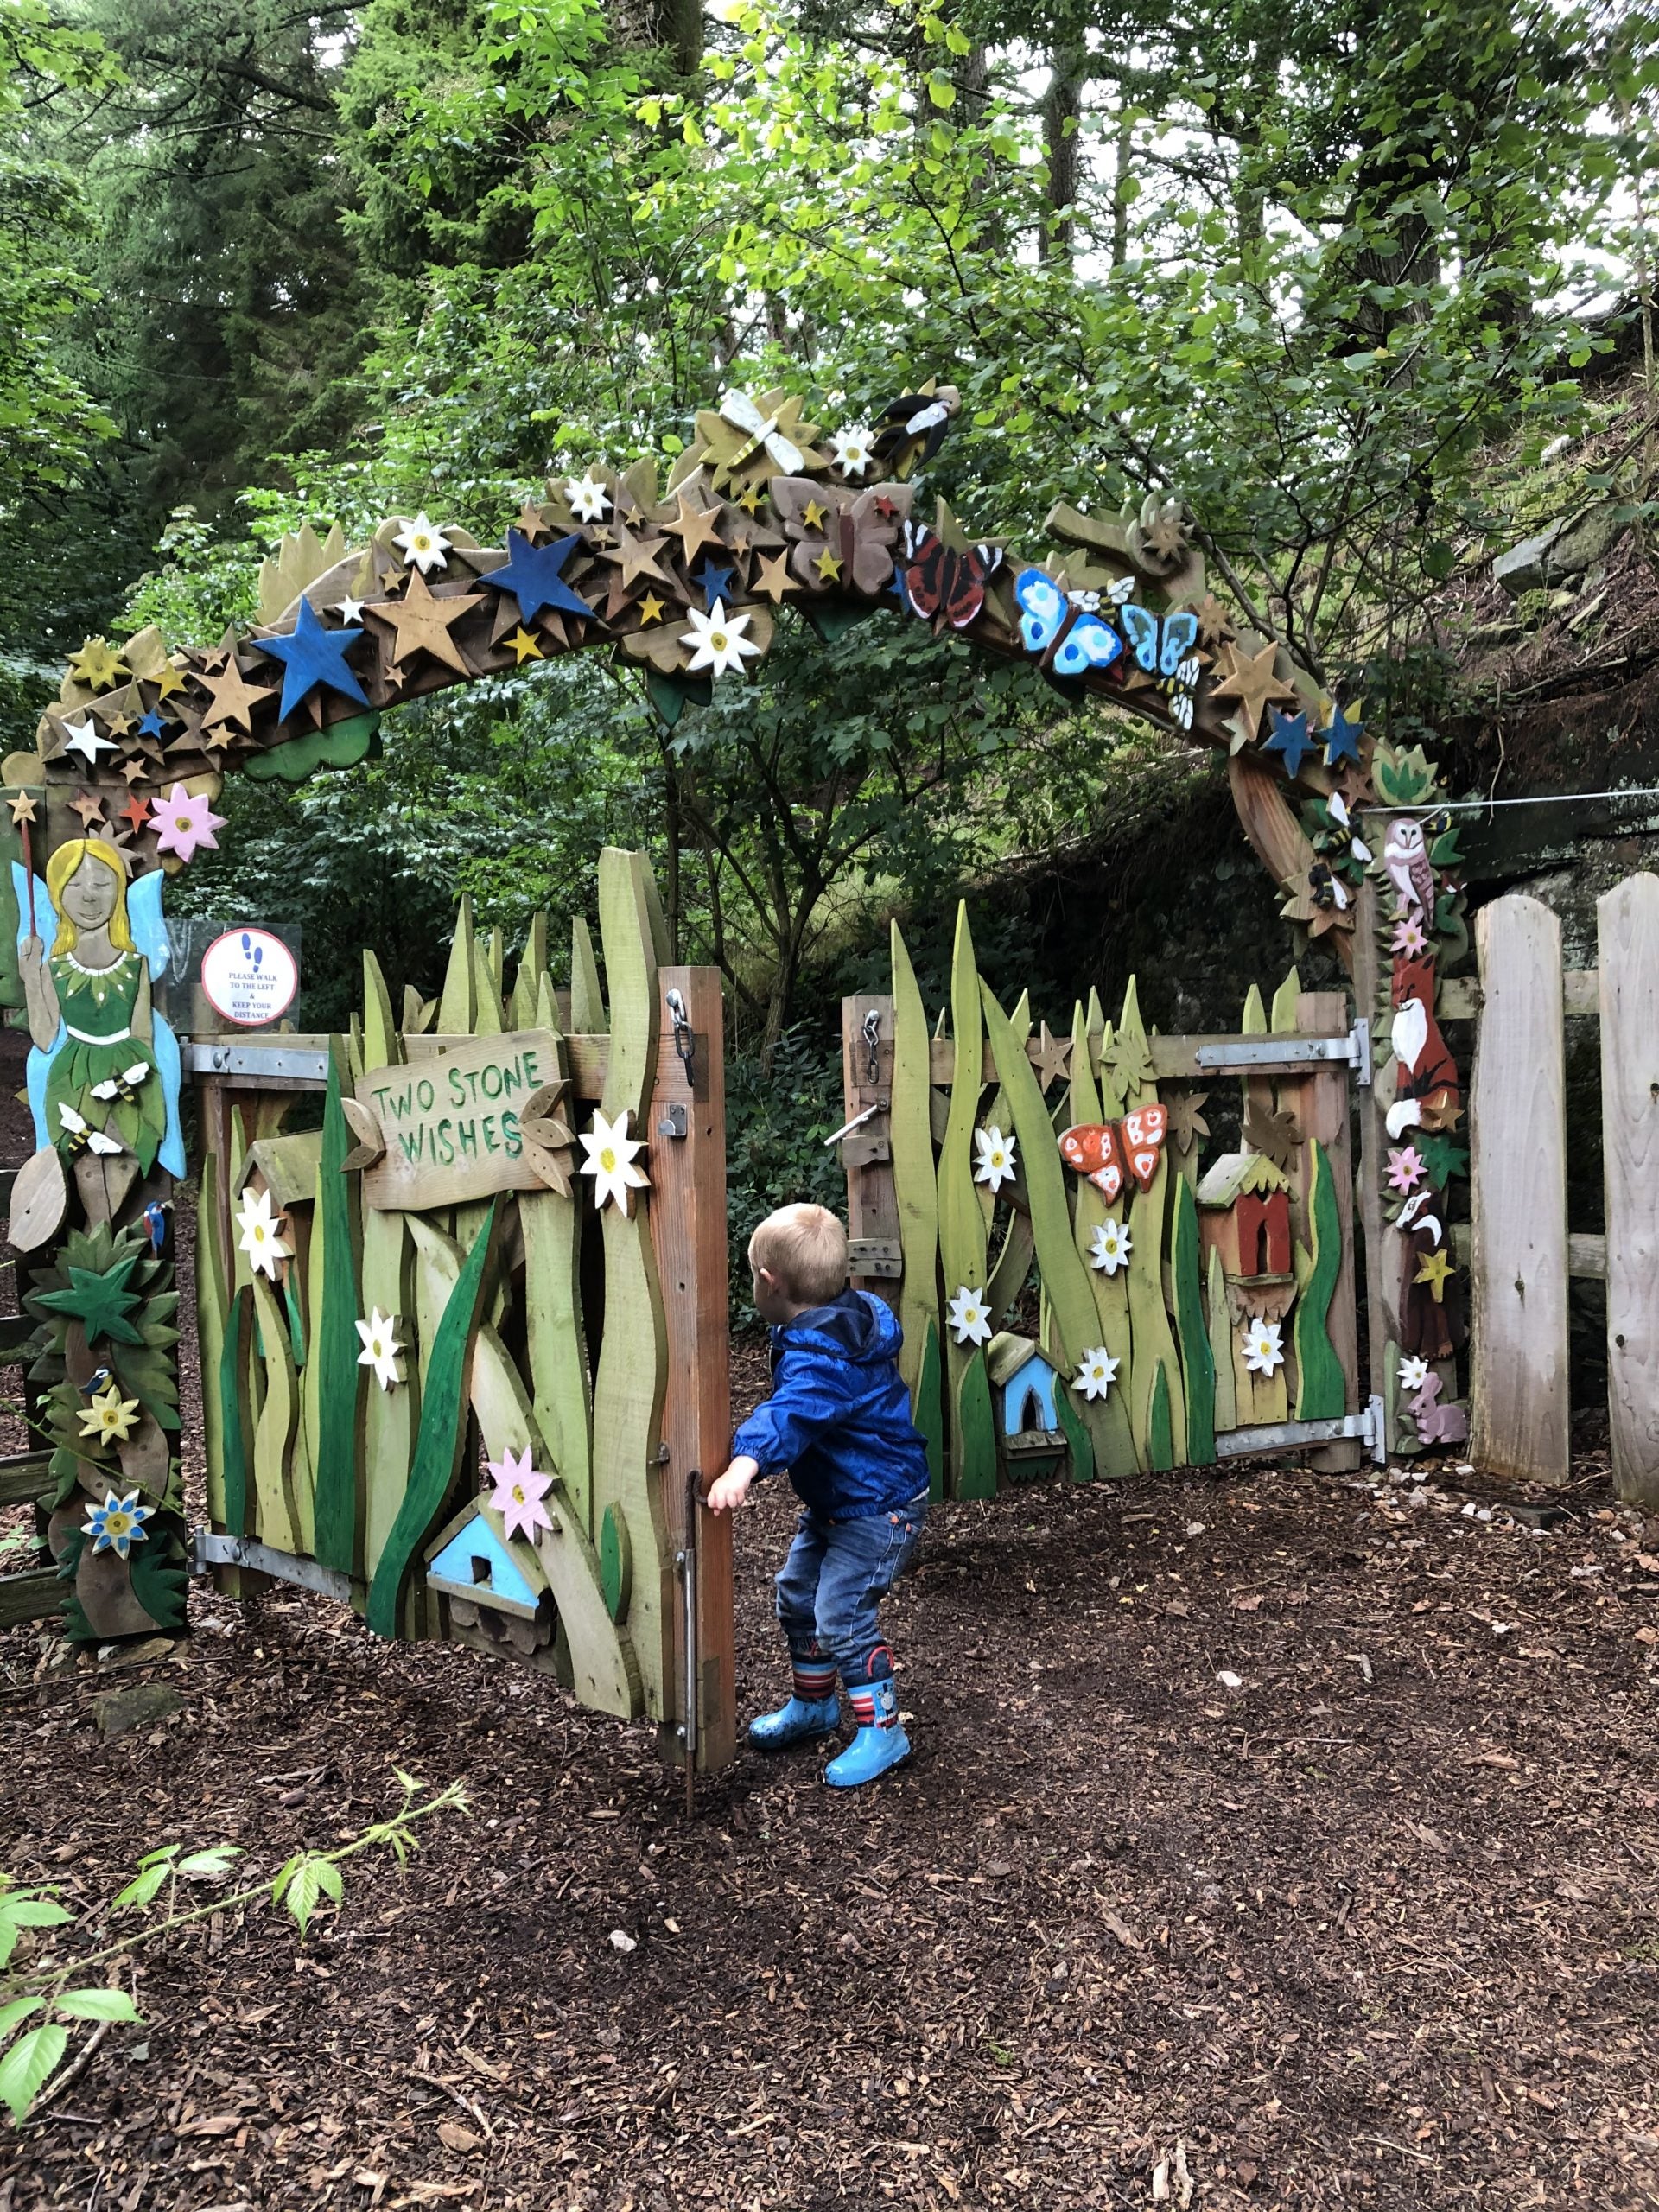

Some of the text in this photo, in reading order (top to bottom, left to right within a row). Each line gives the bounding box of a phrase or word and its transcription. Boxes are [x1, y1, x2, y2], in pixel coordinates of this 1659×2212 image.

[370, 1052, 543, 1121] TWO STONE
[398, 1110, 523, 1166] WISHES
